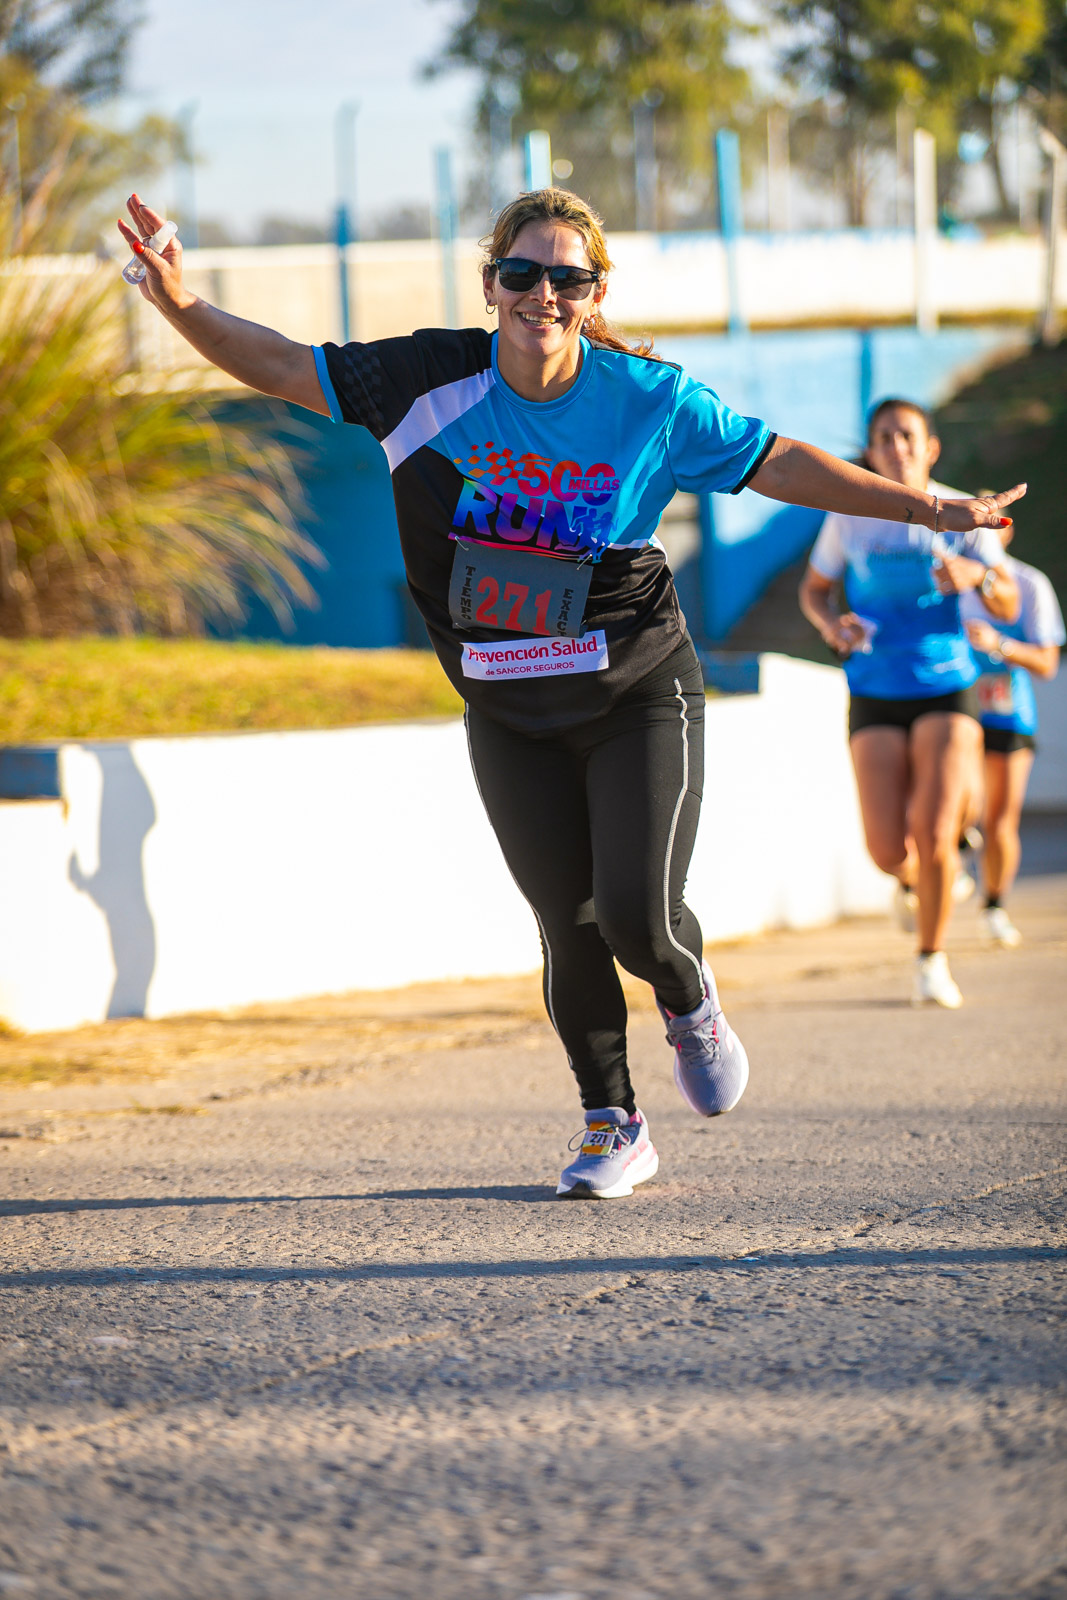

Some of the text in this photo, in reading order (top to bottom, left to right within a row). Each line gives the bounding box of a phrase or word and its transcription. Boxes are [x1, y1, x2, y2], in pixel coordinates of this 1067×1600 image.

[568, 479, 620, 491] MILLAS
[452, 477, 588, 549] RUN
[459, 565, 476, 620] TIEMPO
[476, 576, 552, 636] 271
[468, 636, 598, 663] Prevención Salud
[496, 665, 532, 675] SANCOR
[533, 661, 575, 672] SEGUROS
[590, 1133, 608, 1144] 271
